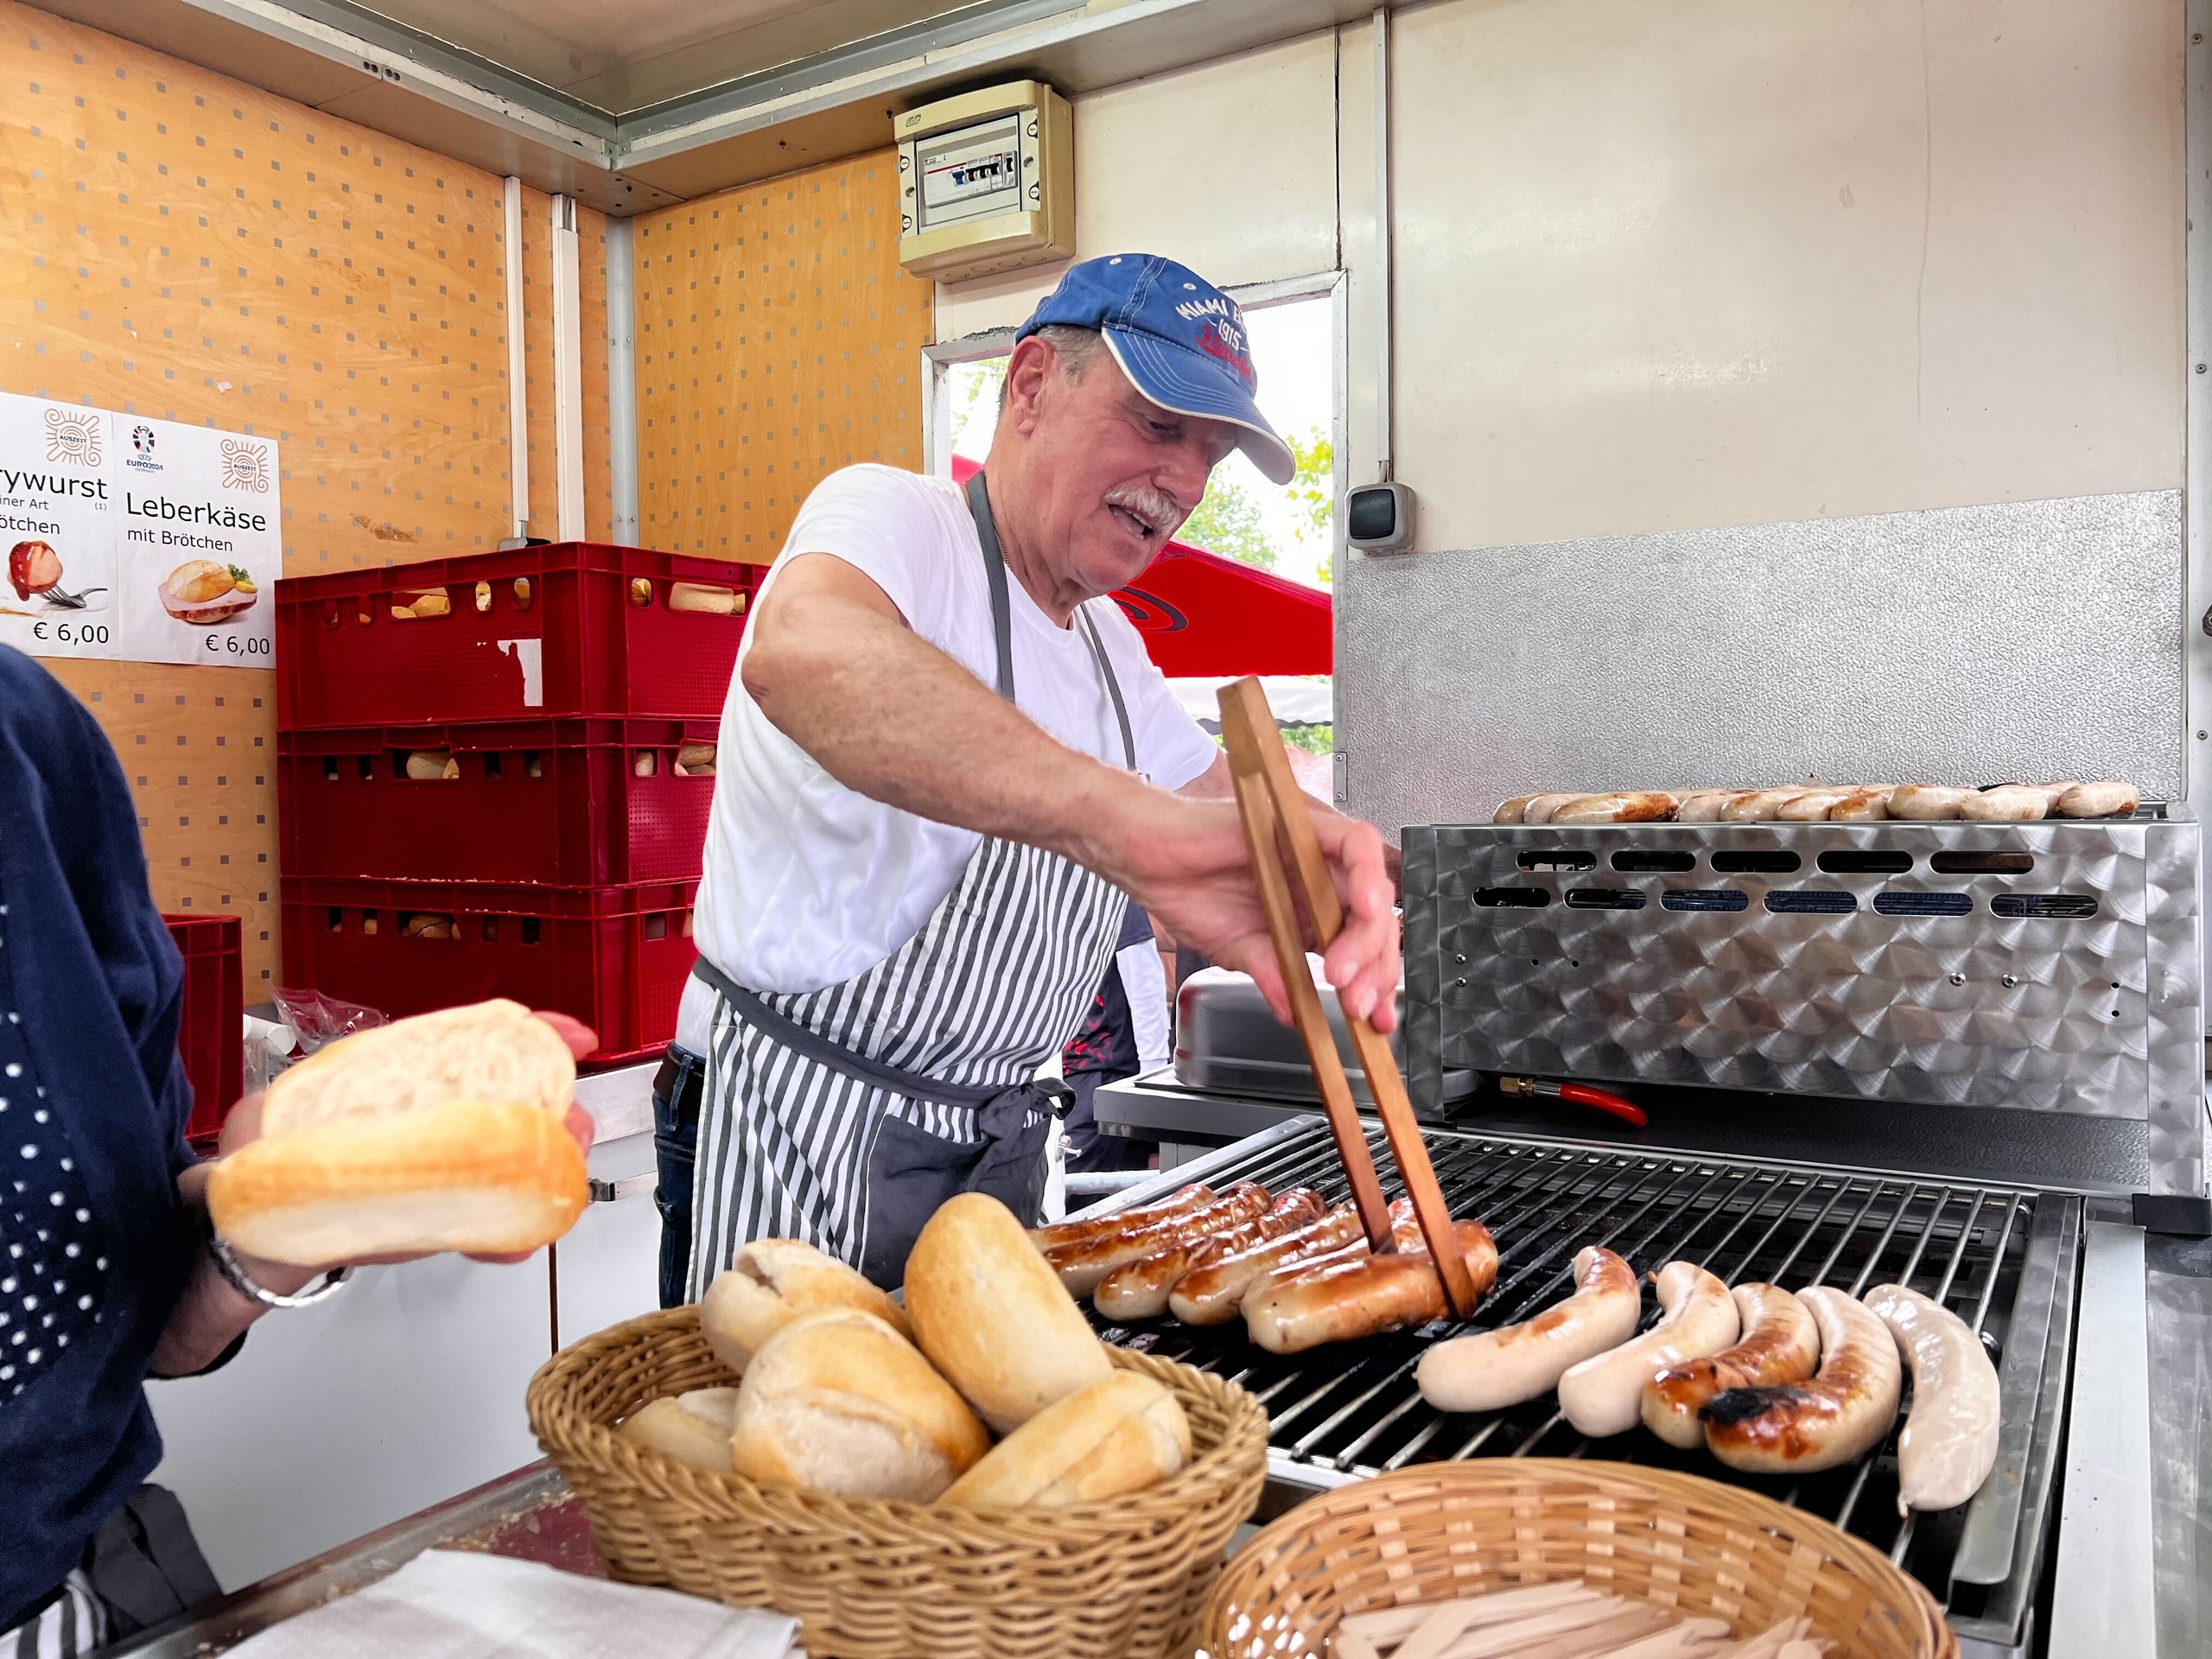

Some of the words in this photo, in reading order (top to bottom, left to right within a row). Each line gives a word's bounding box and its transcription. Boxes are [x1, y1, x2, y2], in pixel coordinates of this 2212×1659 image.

[1175, 298, 1229, 321] MIAMI
[1218, 318, 1242, 350] 1915
[59, 435, 87, 444] AUSZEIT
[233, 463, 257, 472] AUSZEIT
[0, 468, 108, 499] ywurst
[29, 499, 49, 511] Art
[94, 502, 107, 512] (1)
[126, 492, 266, 531] Leberkäse
[0, 514, 60, 535] ötchen
[128, 528, 156, 543] mit
[162, 531, 233, 552] Brötchen
[33, 621, 48, 640] €
[58, 623, 109, 646] 6,00
[205, 633, 219, 652] €
[226, 635, 270, 657] 6,00
